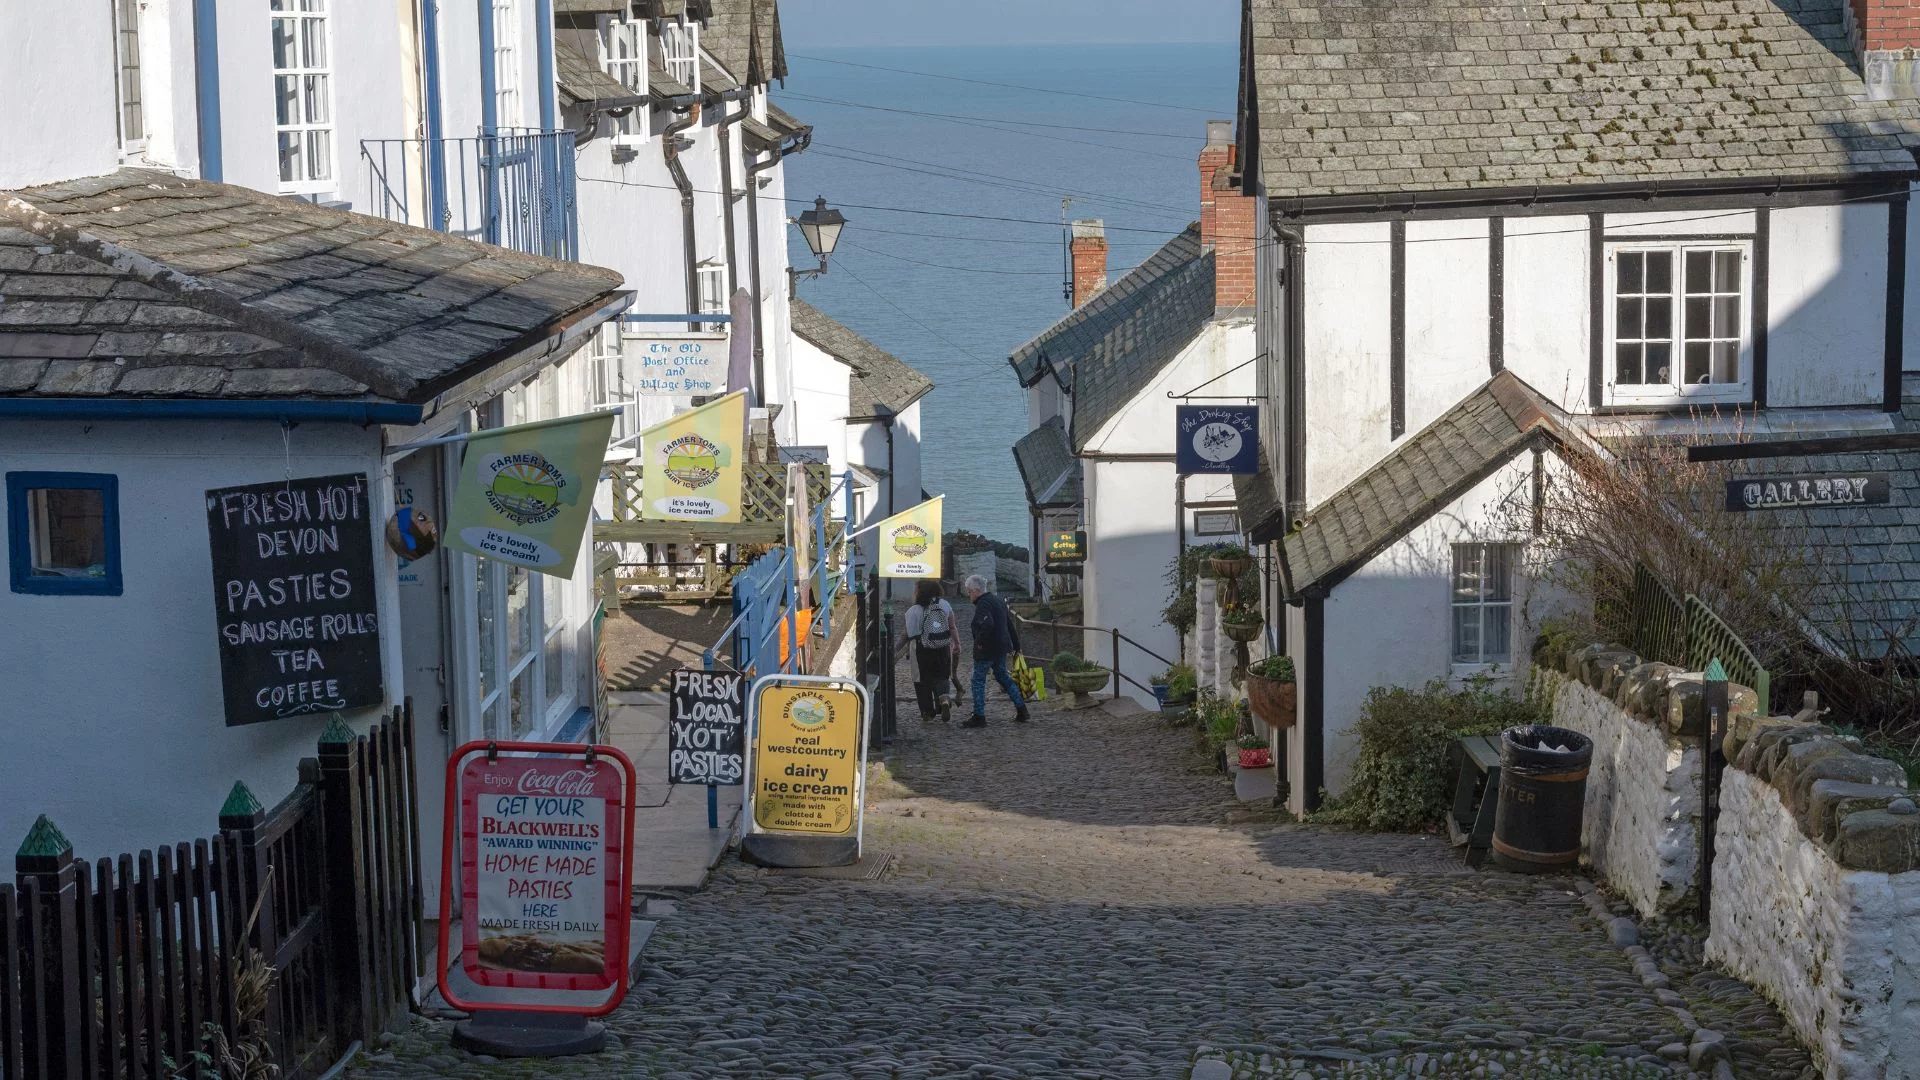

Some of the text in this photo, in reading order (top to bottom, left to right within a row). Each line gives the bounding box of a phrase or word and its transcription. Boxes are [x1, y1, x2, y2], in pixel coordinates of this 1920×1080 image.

[650, 343, 701, 353] The Old
[642, 356, 709, 367] Post Office
[640, 379, 712, 391] Village Shop
[1199, 408, 1231, 423] Donkey
[663, 436, 720, 456] FARMER TOM'S
[490, 454, 567, 488] FARMER TOM'S
[664, 468, 682, 485] DAIRY
[698, 471, 721, 488] CREAM
[1743, 478, 1868, 508] GALLERY
[221, 489, 312, 529] FRESH
[318, 483, 361, 521] HOT
[485, 490, 560, 524] DAIRY ICE CREAM
[668, 506, 714, 516] ice cream!
[686, 500, 711, 509] lovely
[257, 525, 340, 559] DEVON
[480, 540, 540, 563] ice cream!
[487, 531, 538, 554] it's lovely
[226, 568, 351, 612] PASTIES
[222, 613, 377, 645] SAUSAGE ROLLS
[272, 648, 325, 674] TEA
[256, 679, 340, 708] COFFEE
[674, 671, 741, 704] FRESH
[676, 697, 741, 724] LOCAL
[783, 691, 835, 723] DUNSTAPLE FARM
[675, 721, 728, 750] HOT
[795, 736, 820, 745] real
[767, 744, 847, 759] westcountry
[671, 750, 742, 778] PASTIES
[784, 763, 828, 781] dairy
[484, 768, 600, 795] Enjoy Coca-Cola
[763, 778, 848, 795] ice cream
[497, 796, 585, 818] GET YOUR
[783, 801, 825, 810] made with
[807, 794, 841, 802] ingredients
[774, 819, 802, 827] double
[785, 811, 814, 819] clotted
[482, 816, 600, 838] BLACKWELL'S
[485, 854, 596, 876] HOME MADE
[508, 878, 573, 899] PASTIES
[523, 903, 558, 918] HERE
[482, 918, 599, 932] MADE FRESH DAILY
